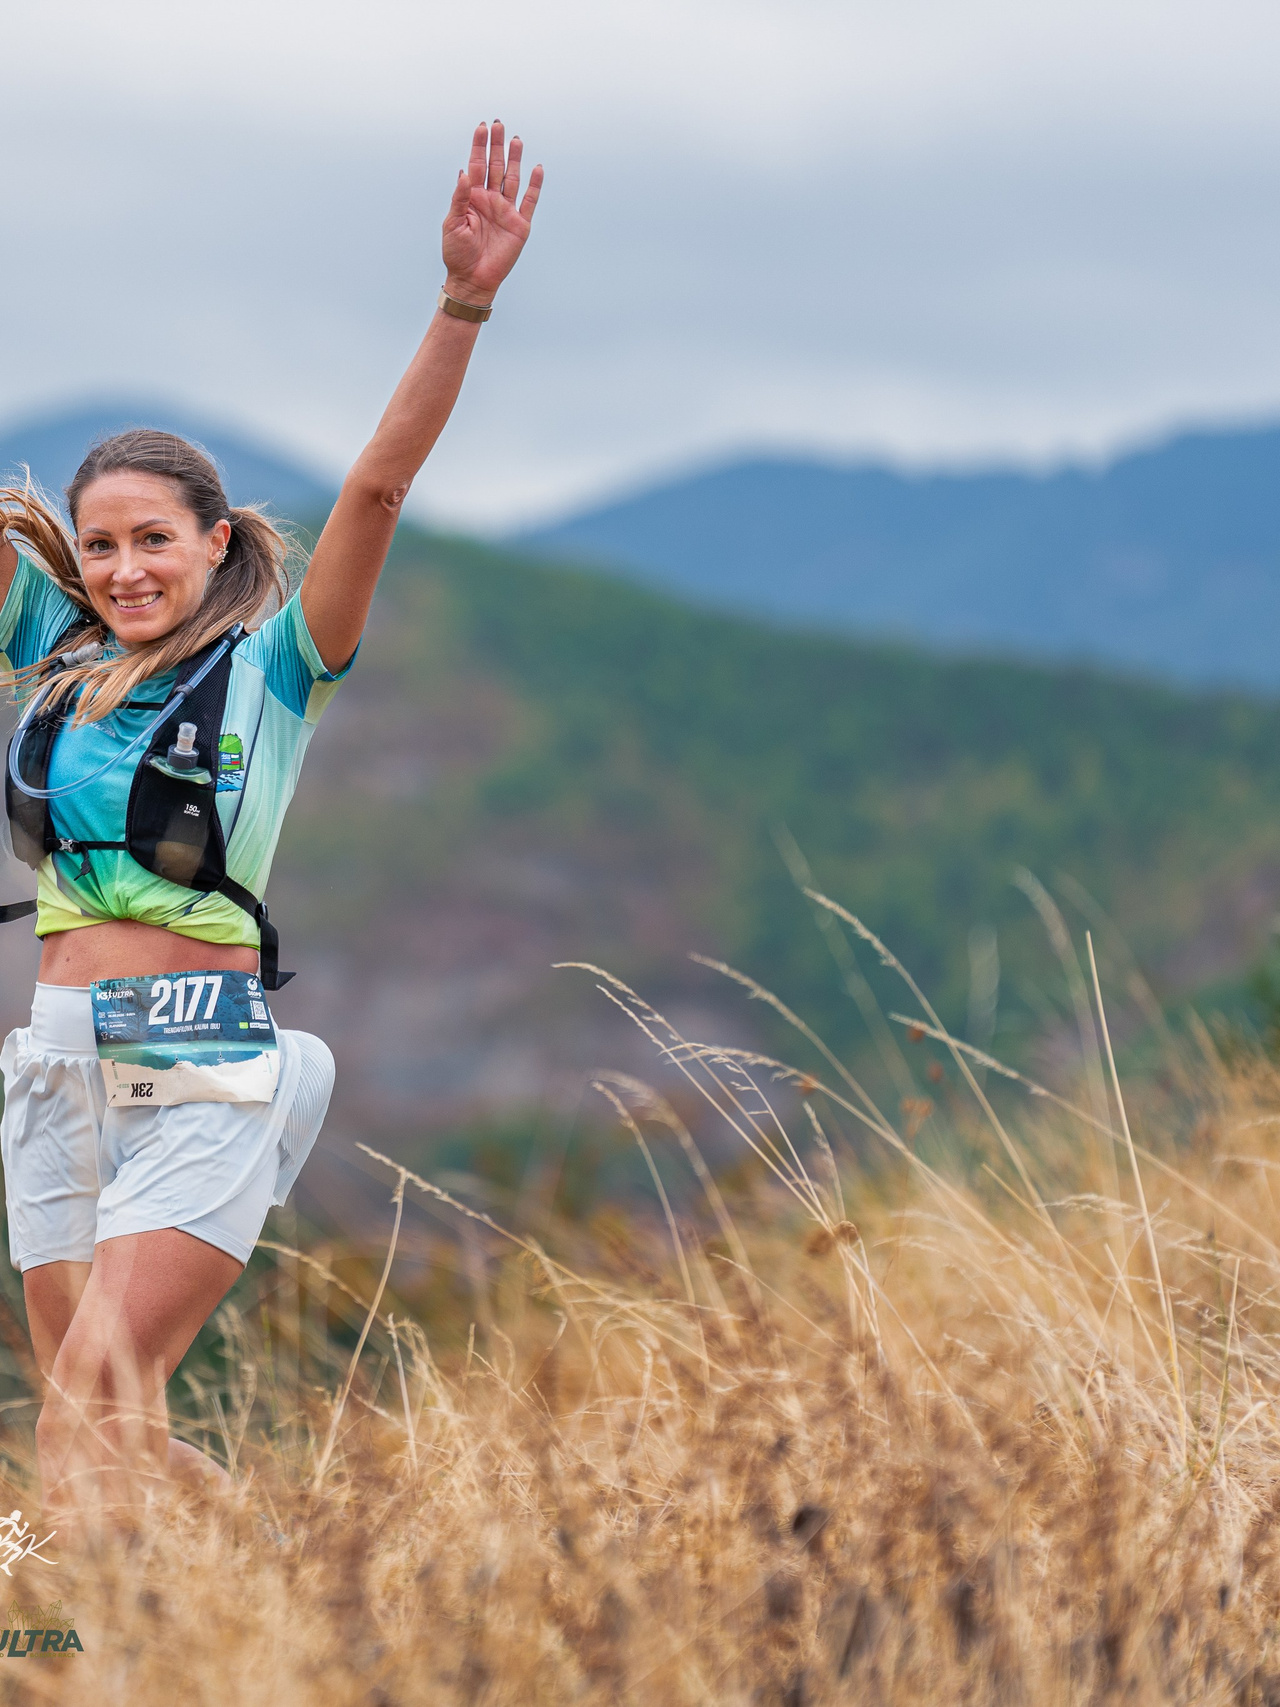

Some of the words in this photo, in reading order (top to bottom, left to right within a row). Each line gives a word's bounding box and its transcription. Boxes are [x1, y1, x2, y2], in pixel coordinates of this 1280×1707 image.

[112, 990, 135, 999] ULTRA
[148, 975, 223, 1026] 2177
[131, 1082, 154, 1098] 23K
